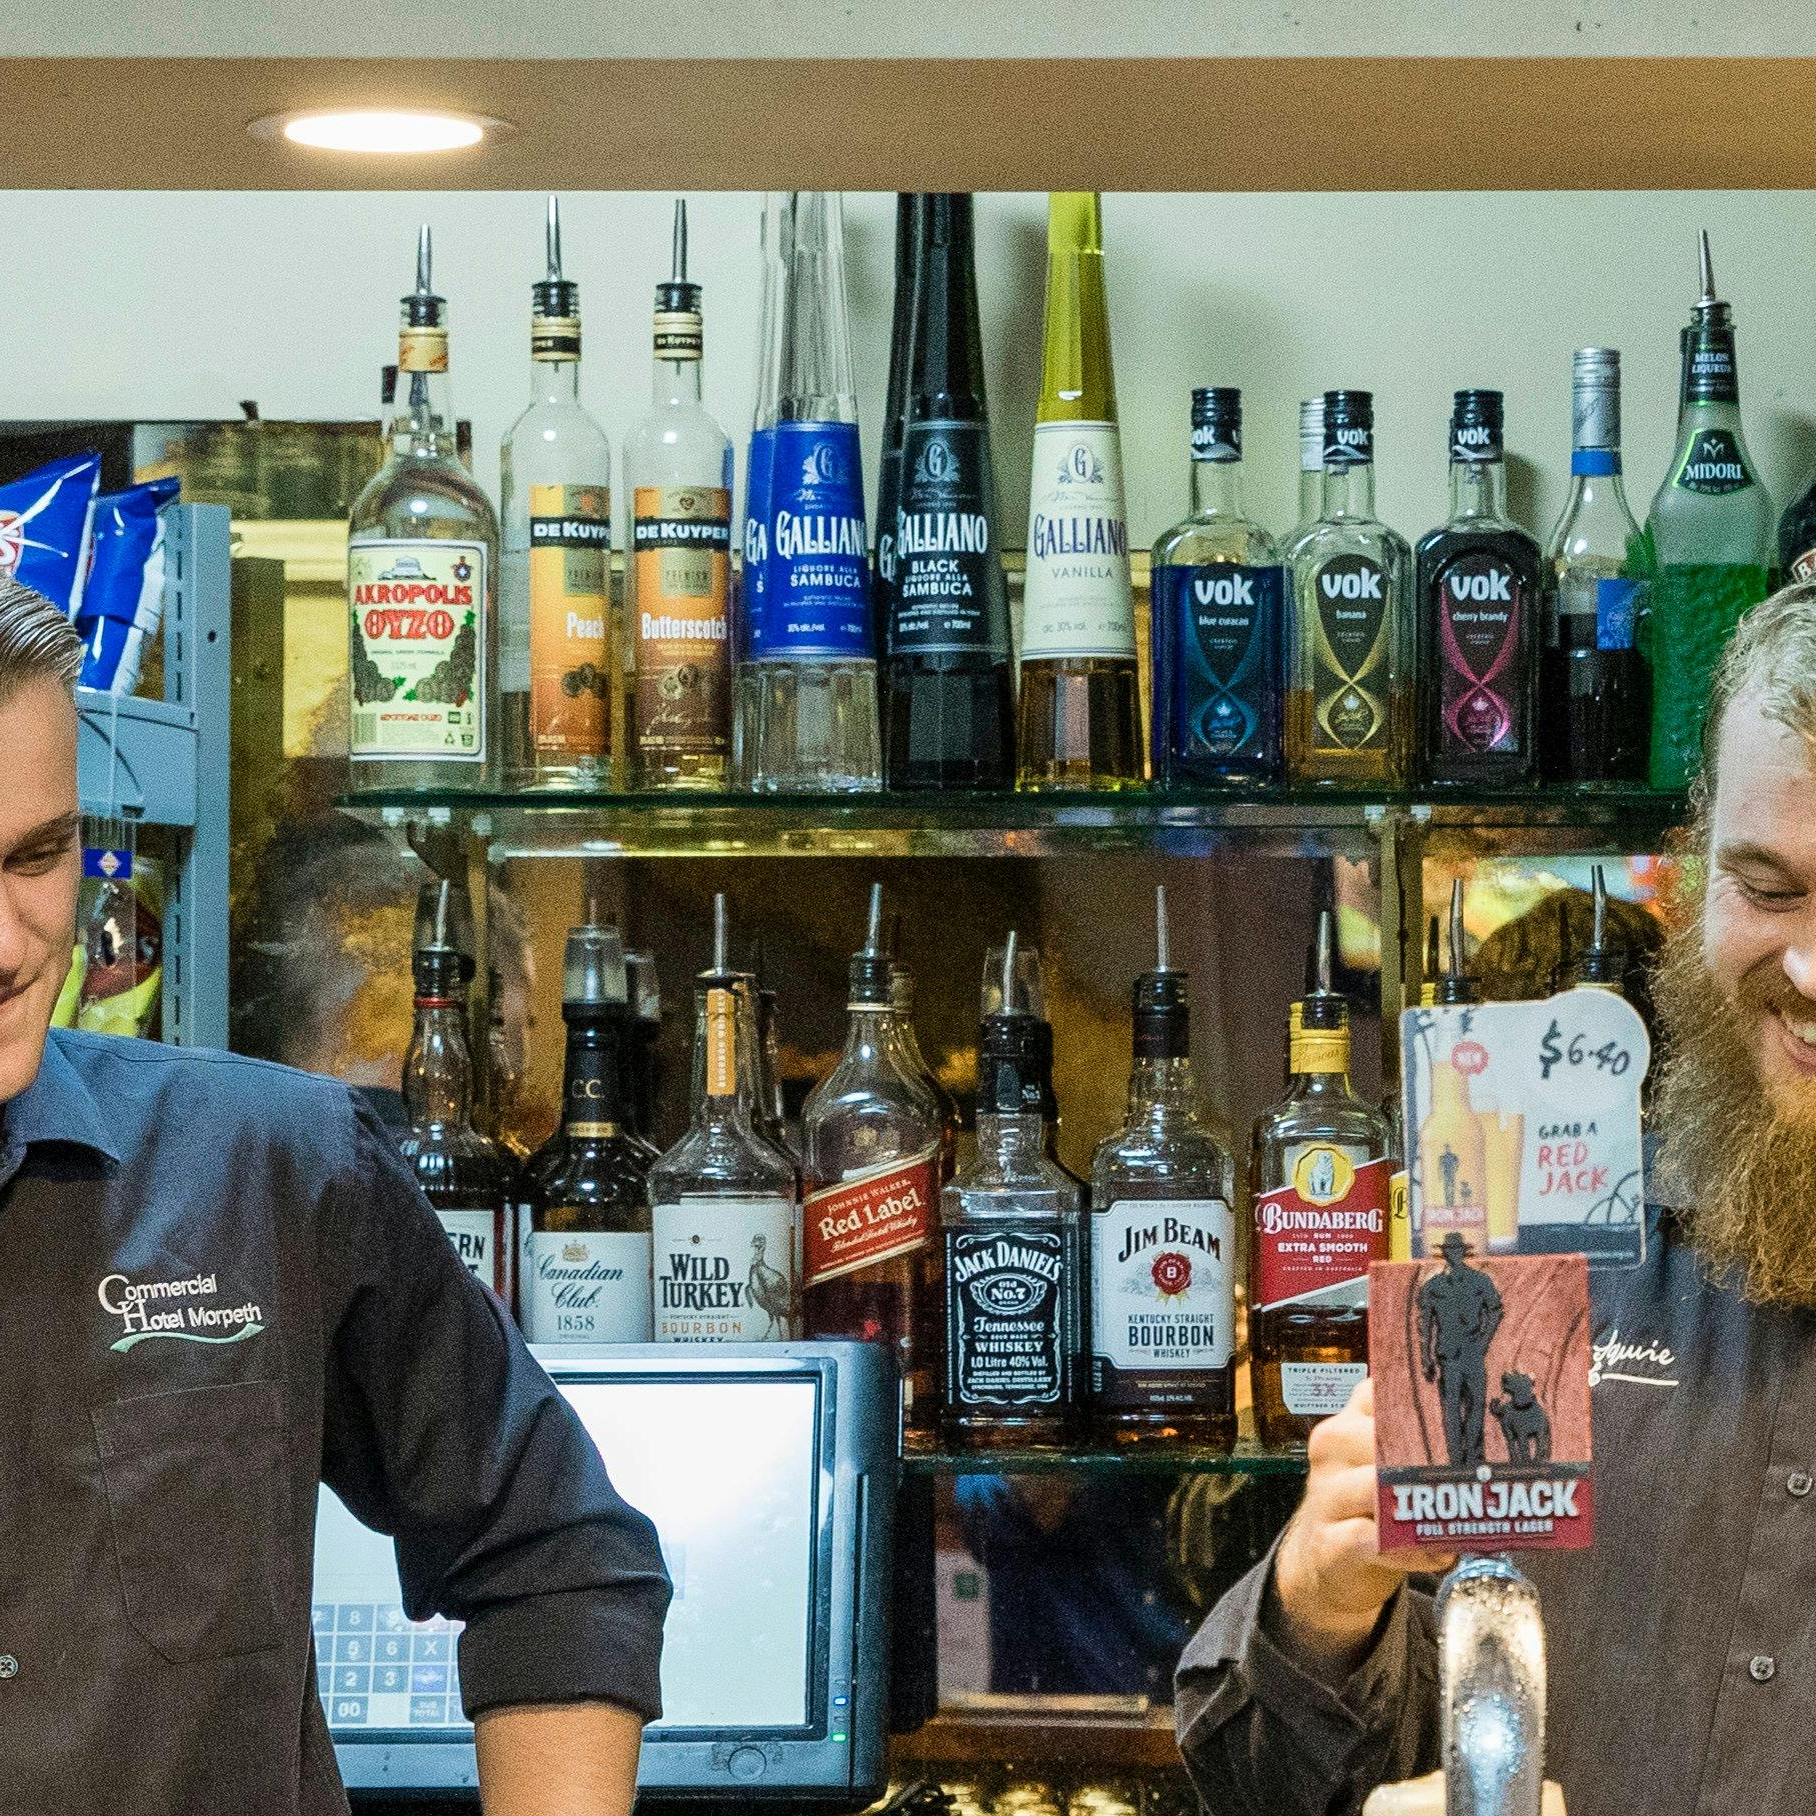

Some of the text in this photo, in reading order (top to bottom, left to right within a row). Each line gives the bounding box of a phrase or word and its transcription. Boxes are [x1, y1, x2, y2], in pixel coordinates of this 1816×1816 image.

[1337, 428, 1368, 445] vok
[1457, 426, 1490, 445] vok
[1685, 464, 1743, 480] MIDORI
[563, 521, 610, 539] KUYP
[897, 506, 988, 559] GALLIANO
[912, 560, 958, 573] BLACK
[1052, 567, 1112, 578] VANILLA
[790, 574, 861, 588] SAMBUCA
[903, 583, 972, 597] SAMBUCA
[1194, 573, 1254, 606] vok
[1322, 566, 1382, 600] vok
[1451, 569, 1511, 601] vok
[355, 584, 473, 605] AKROPOLIS
[1539, 1121, 1598, 1139] GRAB A
[1539, 1141, 1589, 1168] RED
[1539, 1166, 1609, 1196] JACK
[819, 1188, 922, 1241] Red Label
[1263, 1203, 1384, 1234] BUNDABERG
[1118, 1217, 1221, 1263] JIM BEAM
[1278, 1243, 1368, 1253] EXTRA SMOOTH
[537, 1252, 624, 1282] Canadian
[669, 1253, 730, 1281] WILD
[954, 1241, 1064, 1284] JACK DANIEL'S
[99, 1274, 217, 1316] Commercial
[659, 1276, 743, 1309] TURKEY
[991, 1288, 1026, 1300] No.7
[122, 1300, 262, 1334] Hotel Morpeth
[557, 1315, 595, 1330] 1858
[974, 1317, 1045, 1333] Tennessee
[1128, 1314, 1214, 1324] KENTUCKY STRAIGHT
[661, 1322, 742, 1334] BOURBON
[1128, 1326, 1214, 1347] BOURBON
[975, 1342, 1044, 1353] WHISKEY
[1154, 1349, 1190, 1358] WHISKEY
[985, 1356, 1007, 1368] Litre
[1009, 1356, 1030, 1368] 40%
[1393, 1480, 1579, 1521] IRON JACK
[1448, 1521, 1511, 1535] STRENGTH
[387, 1641, 398, 1655] 6
[346, 1672, 396, 1686] 2 3
[338, 1703, 360, 1717] 00
